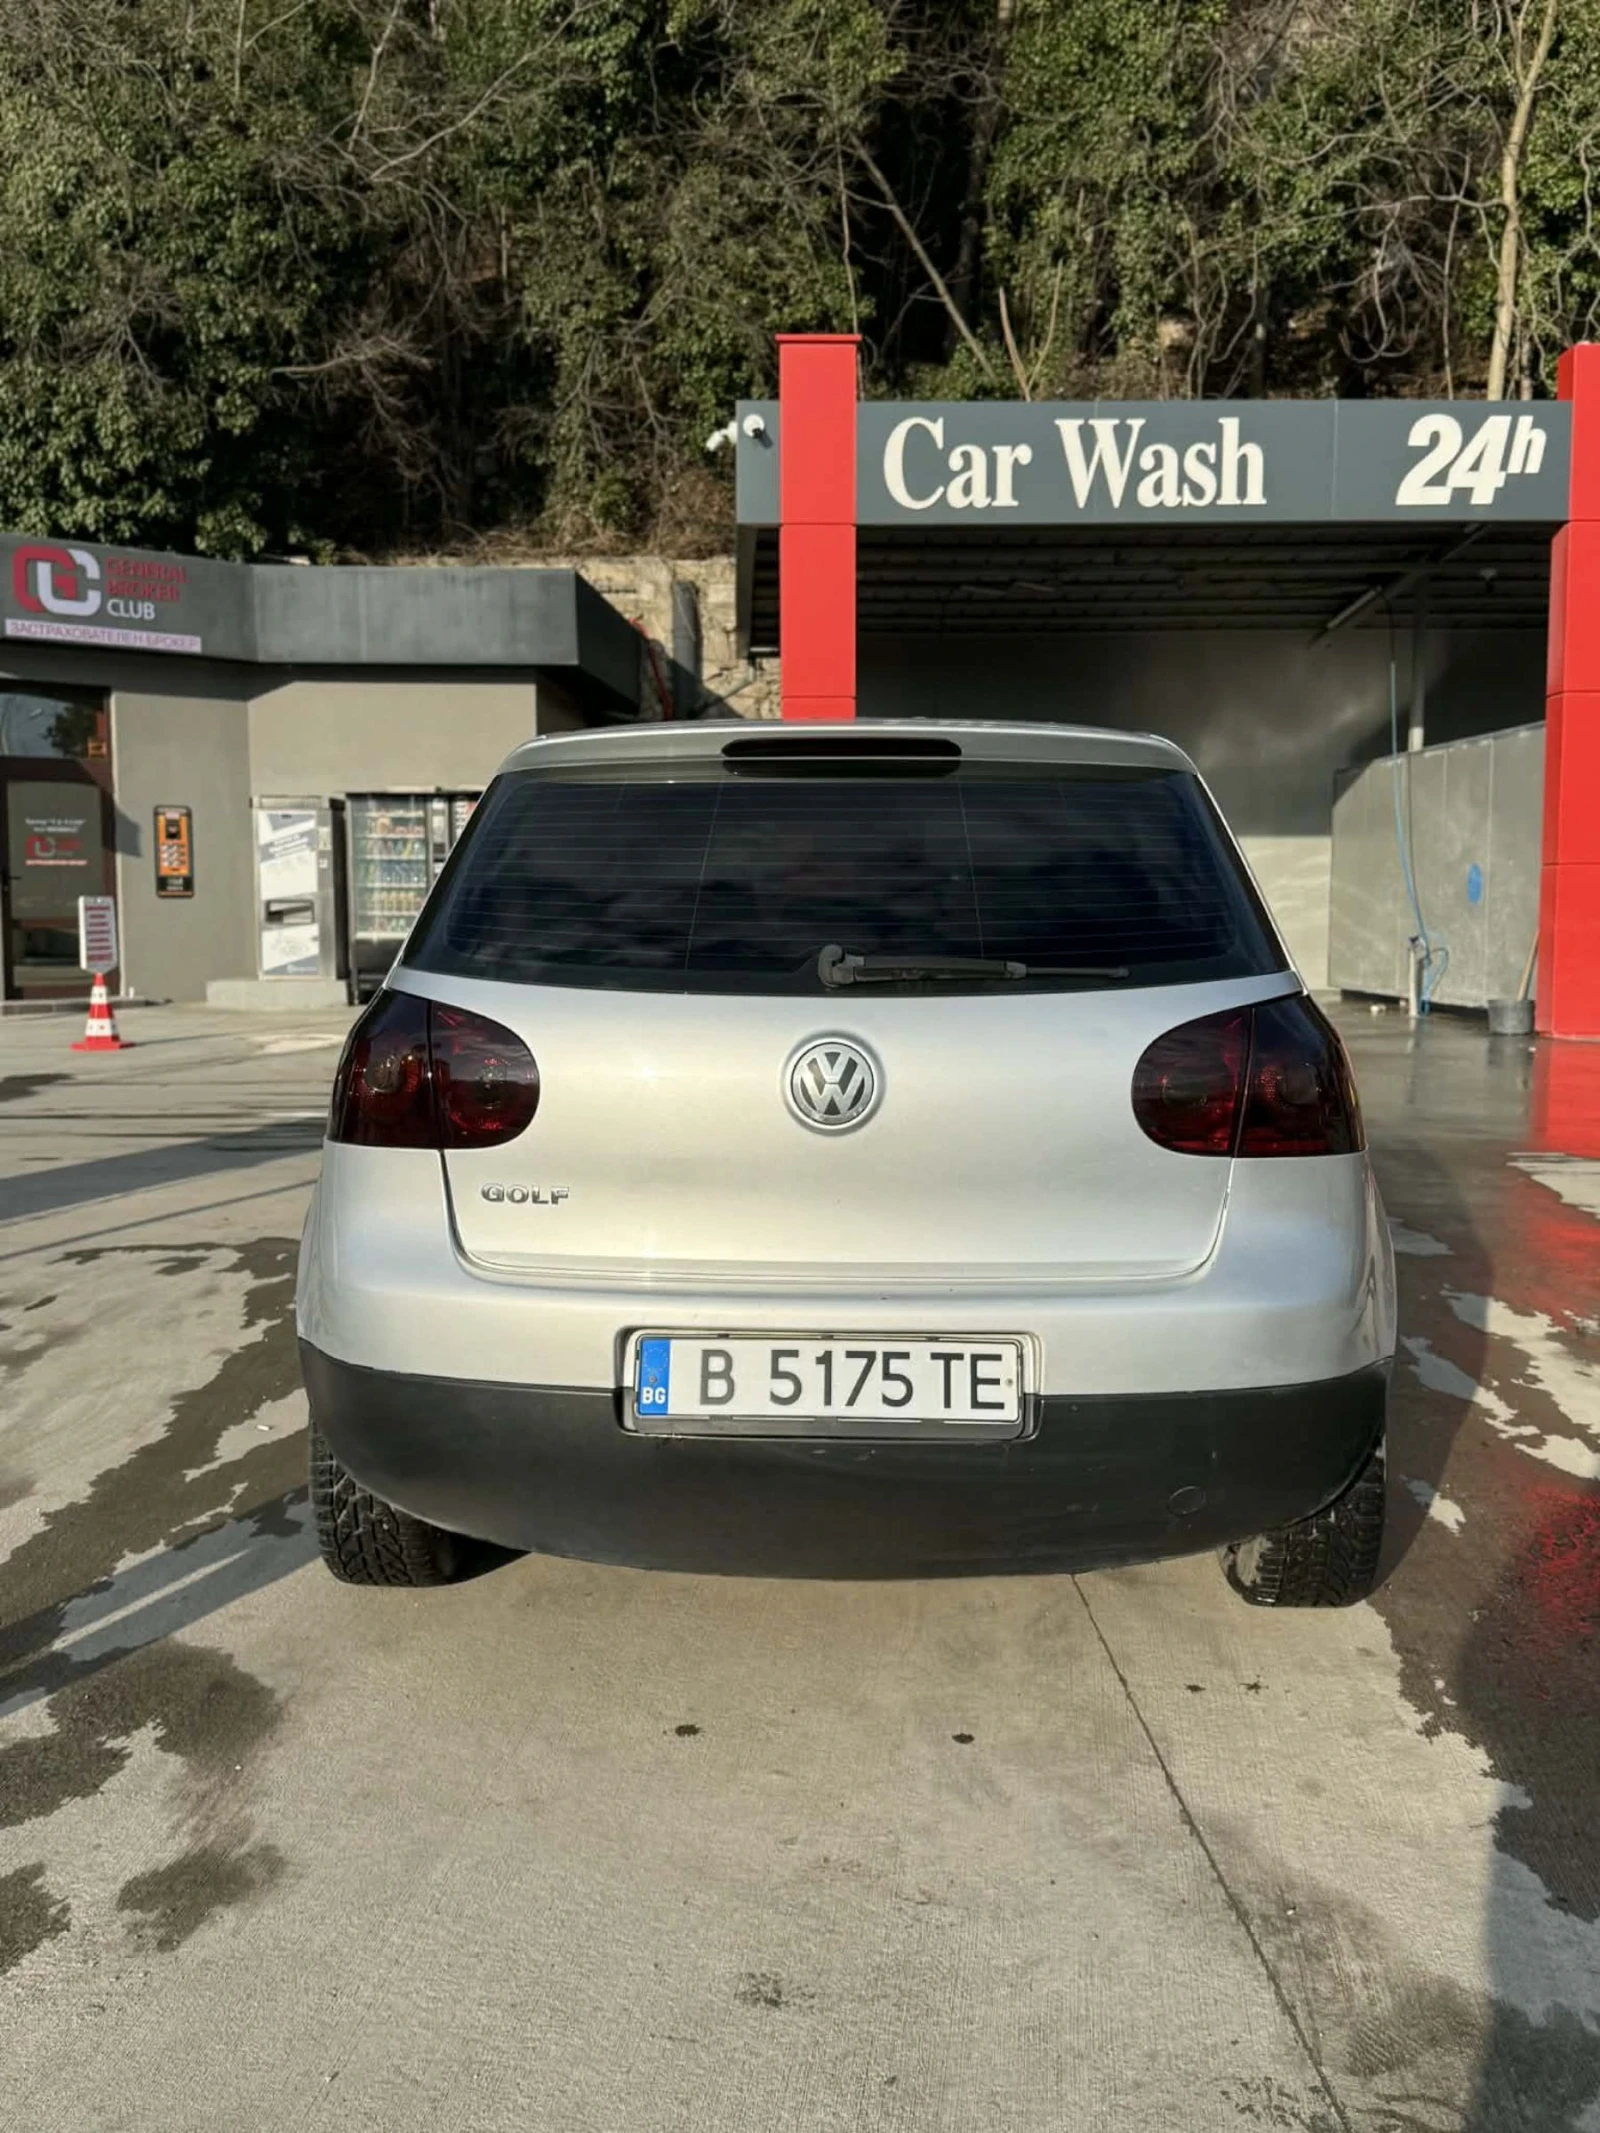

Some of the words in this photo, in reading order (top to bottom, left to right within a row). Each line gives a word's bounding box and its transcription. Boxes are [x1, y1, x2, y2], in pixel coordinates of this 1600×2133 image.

[883, 416, 1032, 510] Car
[1054, 416, 1267, 509] Wash
[1395, 413, 1547, 506] 24h
[106, 598, 156, 620] CLUB
[481, 1183, 569, 1205] GOLF
[641, 1386, 666, 1403] BG
[701, 1349, 735, 1406] B
[769, 1350, 914, 1408] 5175
[930, 1352, 1006, 1411] TE
